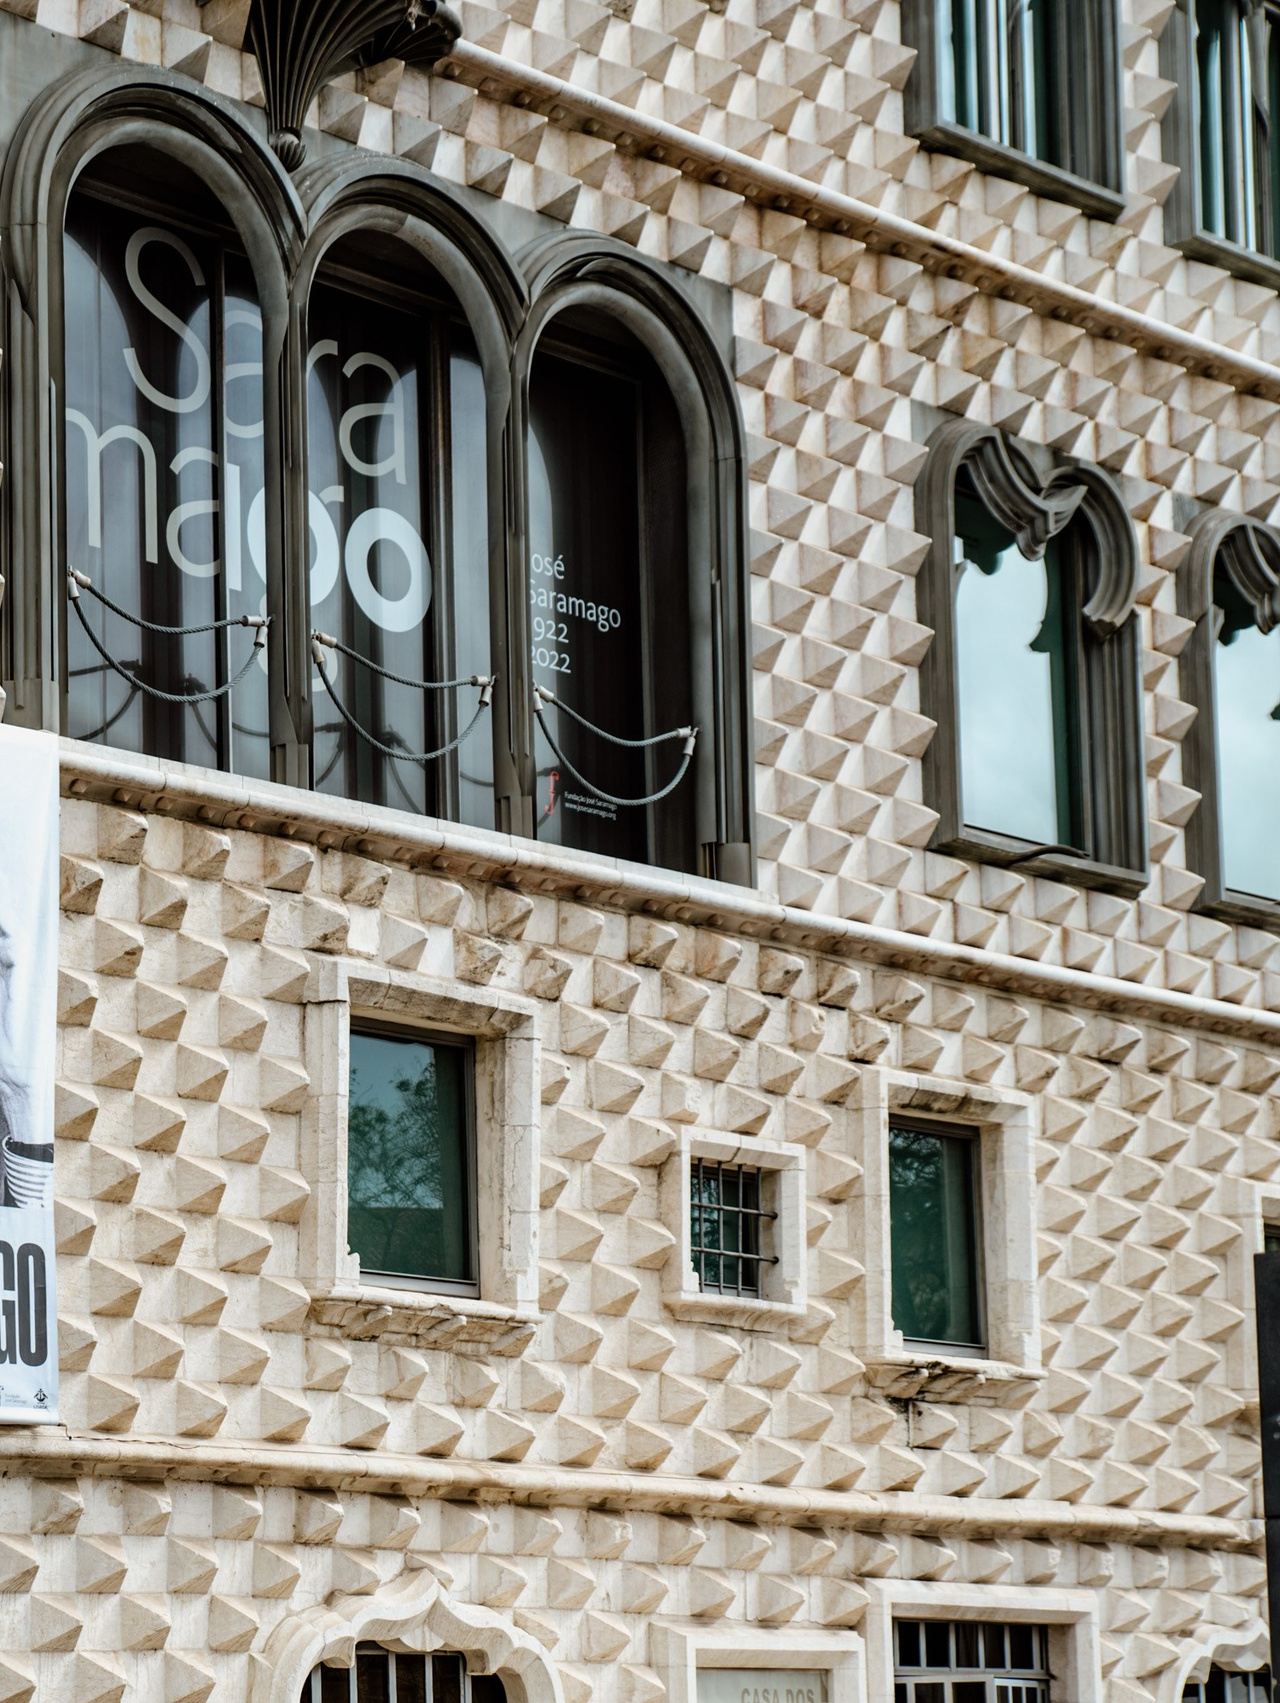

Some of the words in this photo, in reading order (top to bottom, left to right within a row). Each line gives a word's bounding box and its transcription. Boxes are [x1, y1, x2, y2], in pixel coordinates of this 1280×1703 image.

[531, 554, 565, 580] osé
[533, 617, 569, 643] 922
[741, 1687, 779, 1703] CASA
[785, 1688, 815, 1703] DOS
